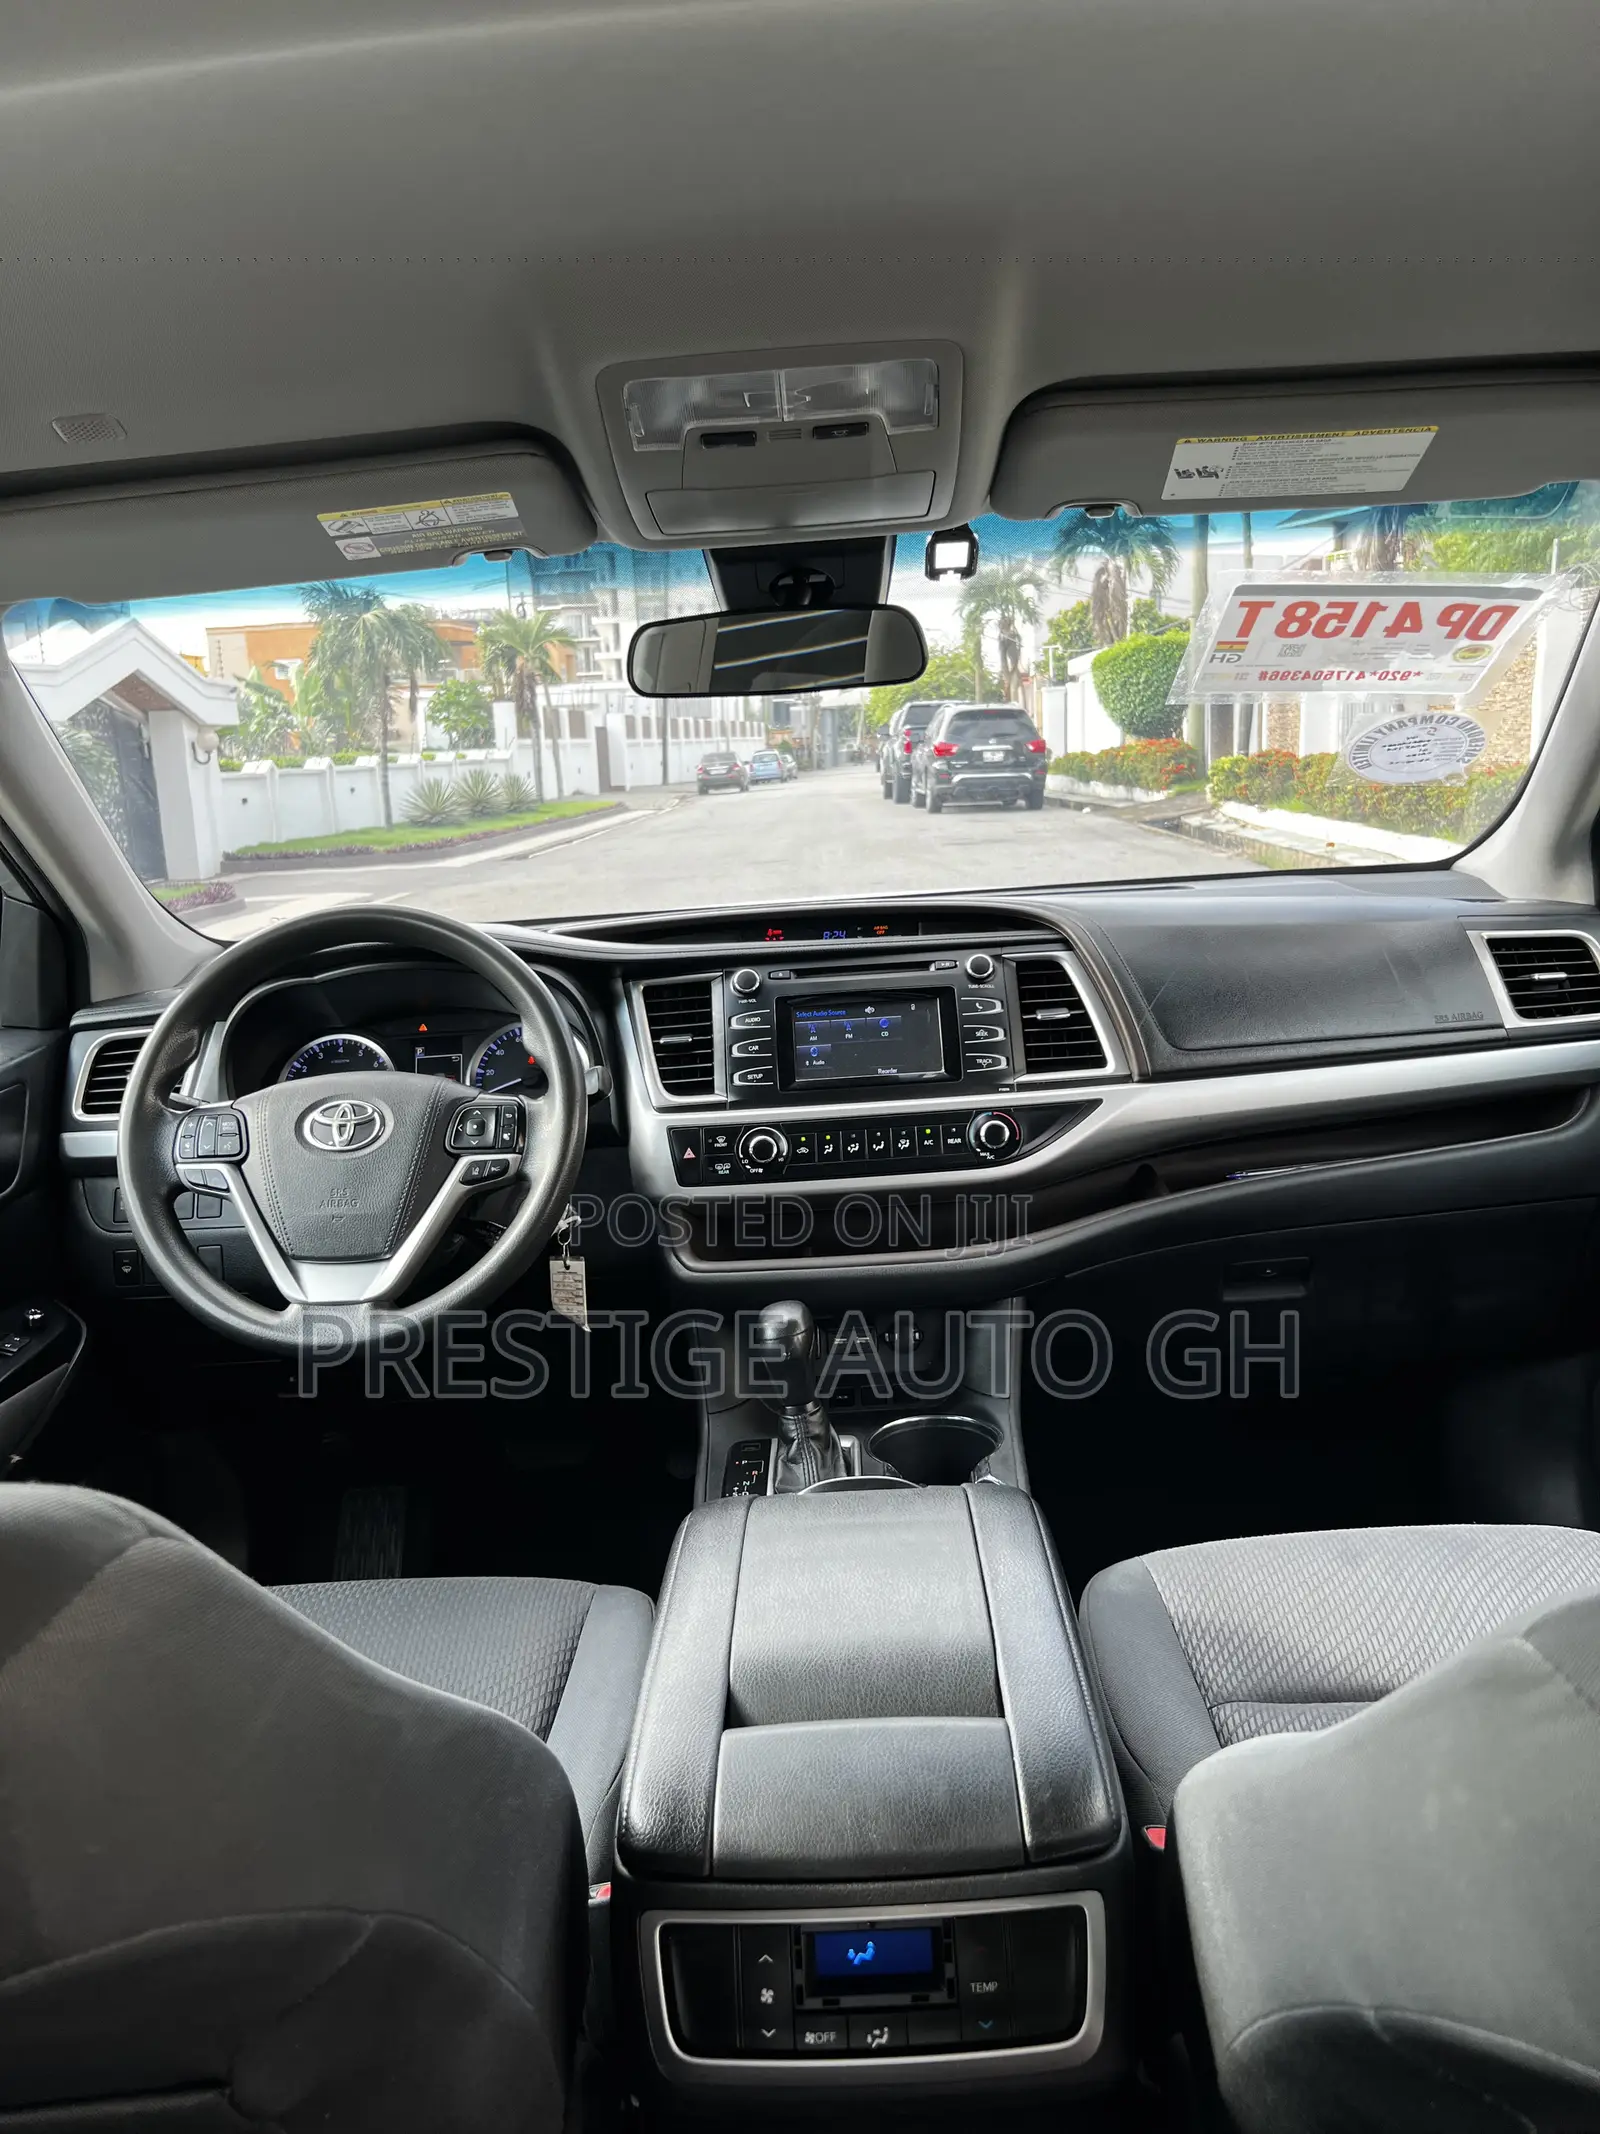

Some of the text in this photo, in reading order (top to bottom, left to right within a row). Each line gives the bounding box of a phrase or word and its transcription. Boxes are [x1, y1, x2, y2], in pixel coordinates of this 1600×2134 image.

[1353, 427, 1432, 437] ADVERTENCIA
[823, 930, 847, 940] 8:24
[1452, 1011, 1484, 1020] AIRBAG
[877, 1067, 898, 1075] Reorder
[330, 1187, 350, 1198] SRS
[319, 1198, 360, 1208] AIRBAG
[970, 1981, 998, 1993] TEMP
[815, 2031, 836, 2043] OFF
